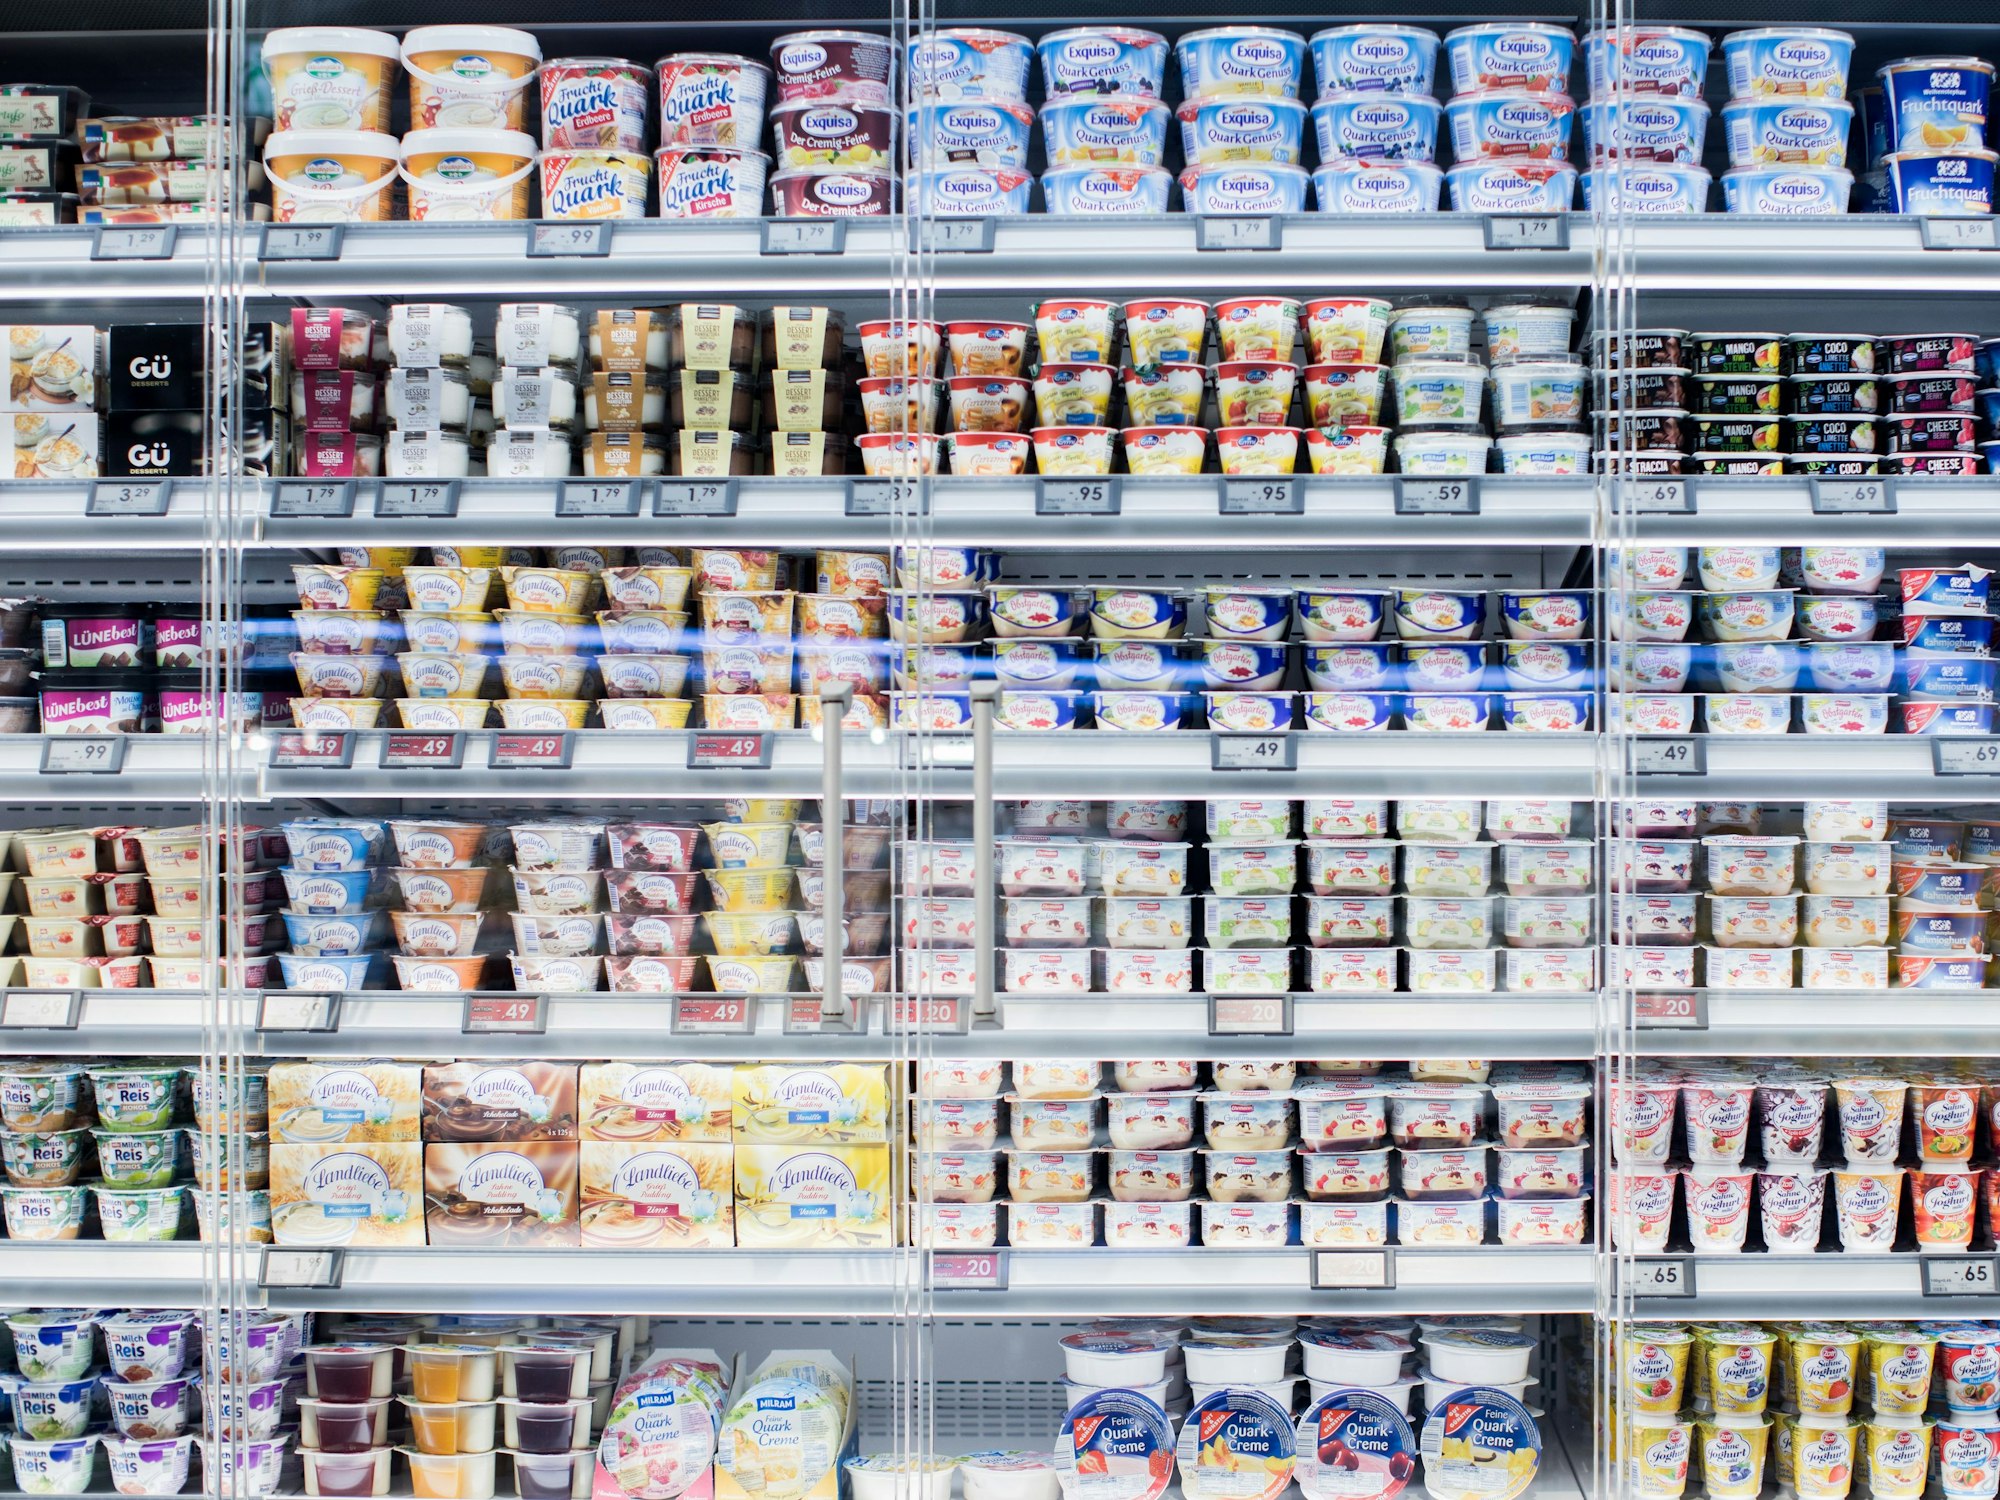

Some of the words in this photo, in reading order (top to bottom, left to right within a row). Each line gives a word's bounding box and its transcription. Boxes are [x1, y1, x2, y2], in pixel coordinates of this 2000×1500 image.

[1069, 45, 1115, 60] Exquisa
[1237, 46, 1282, 60] Exquisa
[1357, 44, 1403, 59] Exquisa
[1500, 41, 1546, 56] Exquisa
[1780, 46, 1826, 63] Exquisa
[783, 50, 821, 65] Exquisa
[559, 81, 601, 102] Frucht
[677, 79, 719, 100] Frucht
[550, 85, 618, 126] Quark
[667, 83, 736, 123] Quark
[1902, 97, 1983, 114] Fruchtquark
[576, 113, 610, 129] Erdbeere
[694, 110, 728, 124] Erdbeere
[806, 115, 852, 131] Exquisa
[949, 114, 996, 130] Exquisa
[1357, 110, 1403, 126] Exquisa
[790, 132, 805, 144] Der
[806, 133, 870, 149] Cremig-Feine
[667, 171, 736, 209] Quark
[820, 182, 867, 198] Exquisa
[1908, 184, 1988, 202] Fruchtquark
[696, 198, 726, 211] Kirsche
[304, 327, 331, 335] DESSERT
[611, 330, 637, 338] DESSERT
[1726, 342, 1755, 354] MANGO
[1824, 342, 1848, 354] COCO
[1916, 339, 1950, 352] CHEESE
[1732, 354, 1745, 362] KIWI
[1824, 354, 1849, 362] LIMETTE
[130, 355, 172, 379] Gü
[1824, 422, 1846, 434] COCO
[1927, 420, 1959, 432] CHEESE
[128, 442, 170, 467] Gü
[1010, 599, 1051, 612] Obstgarten
[1220, 602, 1259, 616] Obstgarten
[1326, 603, 1366, 616] Obstgarten
[1536, 604, 1576, 615] Obstgarten
[74, 624, 137, 646] LÜNEbest
[1924, 638, 1976, 649] Rahmjoghurt
[1214, 651, 1251, 665] Obstgarten
[315, 667, 359, 683] Landliebe
[414, 667, 454, 683] Landliebe
[1926, 682, 1978, 693] Rahmjoghurt
[46, 696, 108, 718] LÜNEbest
[307, 840, 349, 855] Landliebe
[408, 839, 449, 852] Landliebe
[714, 837, 758, 852] Landliebe
[320, 854, 336, 862] Reis
[1923, 890, 1973, 901] Rahmjoghurt
[411, 926, 453, 939] Landliebe
[1915, 935, 1966, 945] Rahmjoghurt
[129, 1082, 150, 1090] Milch
[319, 1081, 374, 1102] Landliebe
[5, 1091, 31, 1104] Reis
[121, 1089, 150, 1102] Reis
[647, 1111, 665, 1119] Zimt
[1720, 1104, 1742, 1113] Sahne
[1942, 1104, 1965, 1113] Sahne
[1710, 1109, 1745, 1124] Joghurt
[1930, 1109, 1968, 1124] Joghurt
[115, 1148, 143, 1161] Reis
[313, 1165, 383, 1191] Landliebe
[471, 1165, 537, 1190] Landliebe
[623, 1165, 693, 1190] Landliebe
[779, 1165, 849, 1191] Landliebe
[331, 1192, 361, 1200] Pudding
[487, 1191, 517, 1199] Pudding
[640, 1191, 671, 1200] Pudding
[1777, 1189, 1800, 1198] Sahne
[647, 1205, 668, 1213] Zimt
[1768, 1195, 1807, 1211] Joghurt
[799, 1208, 828, 1216] Vanille
[115, 1343, 145, 1357] Reis
[1733, 1358, 1757, 1368] Sahne
[1817, 1360, 1842, 1368] Sahne
[1722, 1364, 1763, 1378] Joghurt
[1808, 1364, 1847, 1378] Joghurt
[640, 1394, 672, 1405] MILRAM
[760, 1397, 793, 1408] MILRAM
[24, 1401, 56, 1414] Reis
[118, 1401, 148, 1415] Reis
[1486, 1409, 1508, 1419] Feine
[1112, 1417, 1134, 1425] Feine
[1203, 1413, 1213, 1424] GUT
[1239, 1414, 1263, 1424] Feine
[1323, 1411, 1333, 1421] GUT
[1324, 1412, 1345, 1432] GÜNSTIG
[1359, 1413, 1382, 1423] Feine
[634, 1416, 673, 1431] Quark
[753, 1420, 792, 1434] Quark
[1204, 1413, 1226, 1436] GÜNSTIG
[1347, 1422, 1393, 1437] Quark-
[1473, 1419, 1518, 1433] Quark-
[641, 1429, 680, 1442] Creme
[1101, 1426, 1148, 1440] Quark-
[1227, 1425, 1273, 1439] Quark-
[759, 1434, 799, 1447] Creme
[1228, 1439, 1269, 1452] Creme
[1348, 1438, 1389, 1451] Creme
[1473, 1434, 1514, 1447] Creme
[1104, 1442, 1145, 1454] Creme
